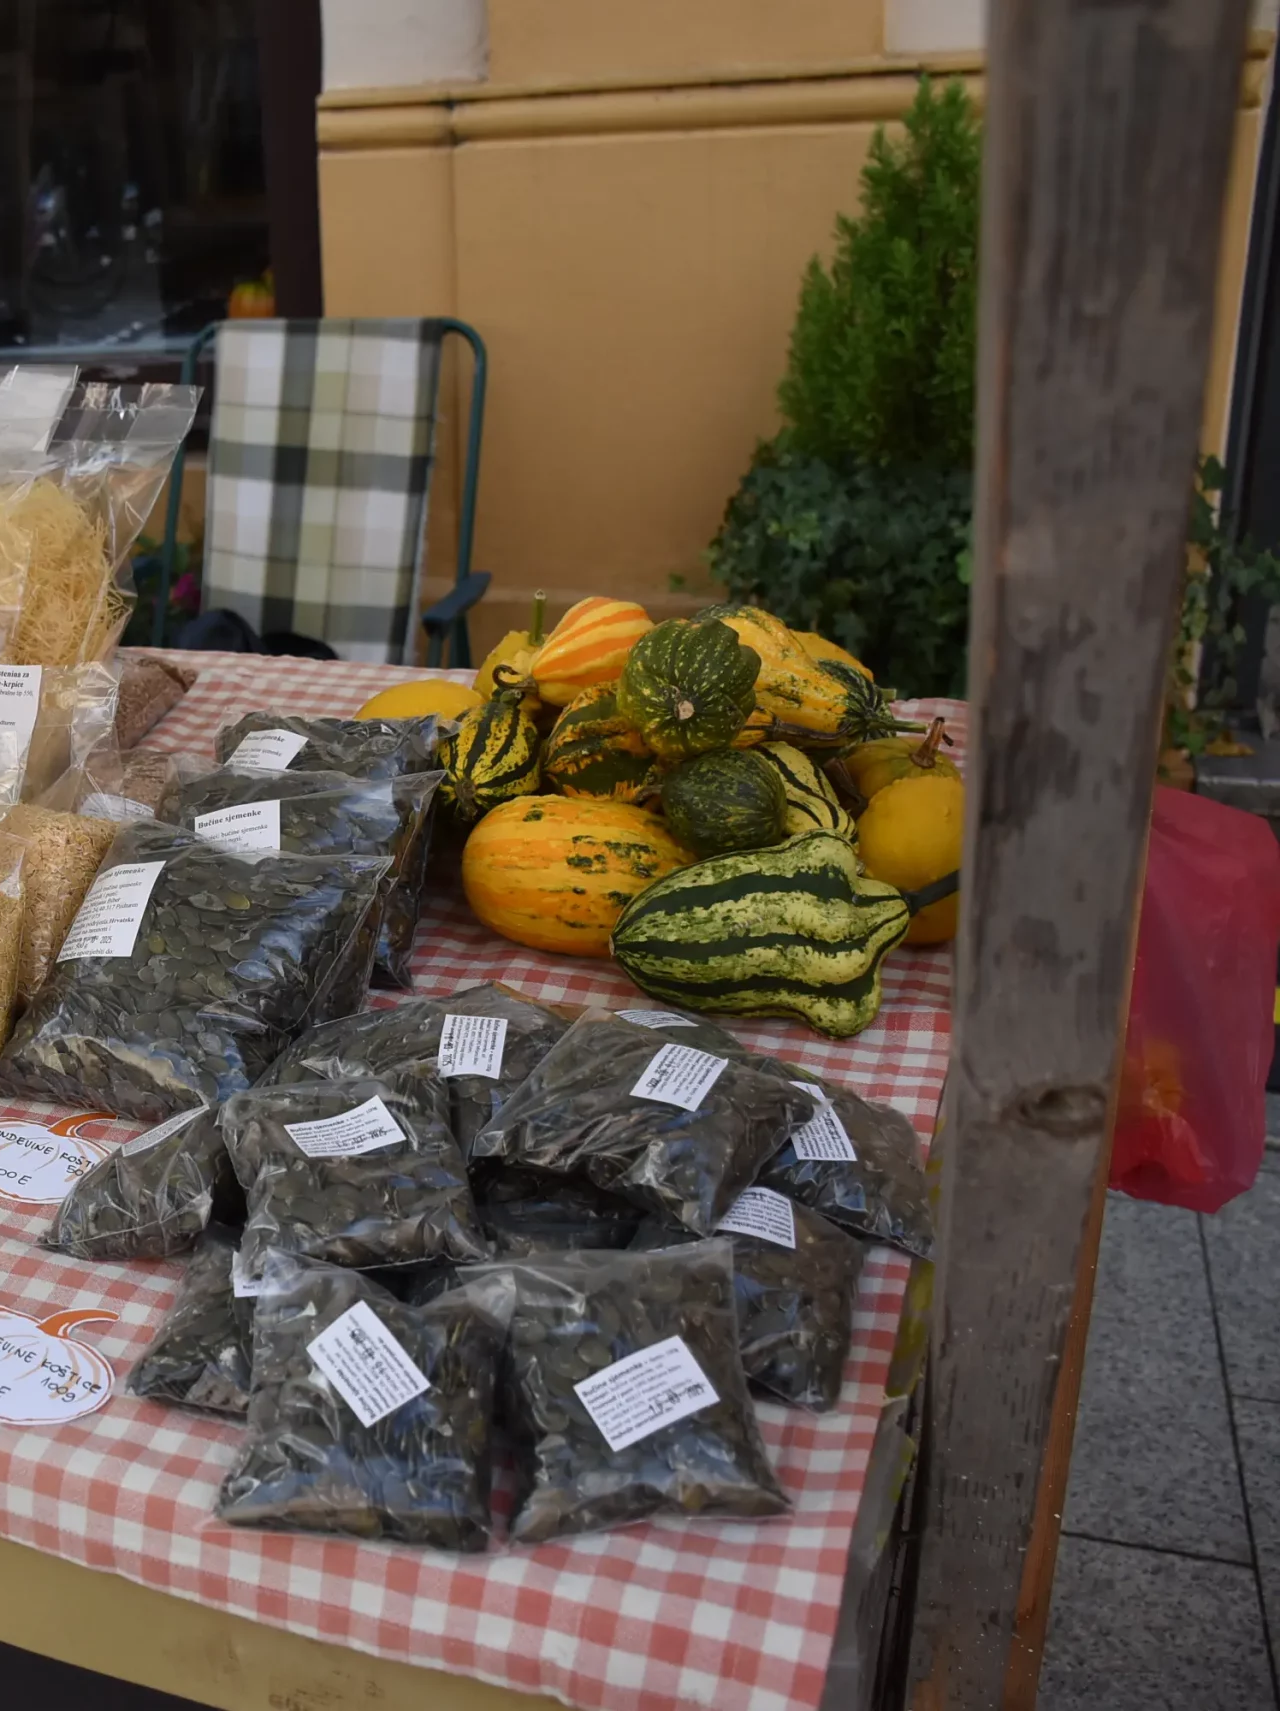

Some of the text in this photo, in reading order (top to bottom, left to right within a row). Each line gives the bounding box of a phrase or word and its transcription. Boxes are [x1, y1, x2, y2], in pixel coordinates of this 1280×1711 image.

[198, 810, 261, 829] Bučine sjemenke
[241, 824, 268, 834] sjemenke
[59, 1152, 95, 1169] KOŠTI
[66, 1164, 84, 1177] 50
[41, 1358, 103, 1394] KOŠTICE
[41, 1377, 76, 1403] 100g
